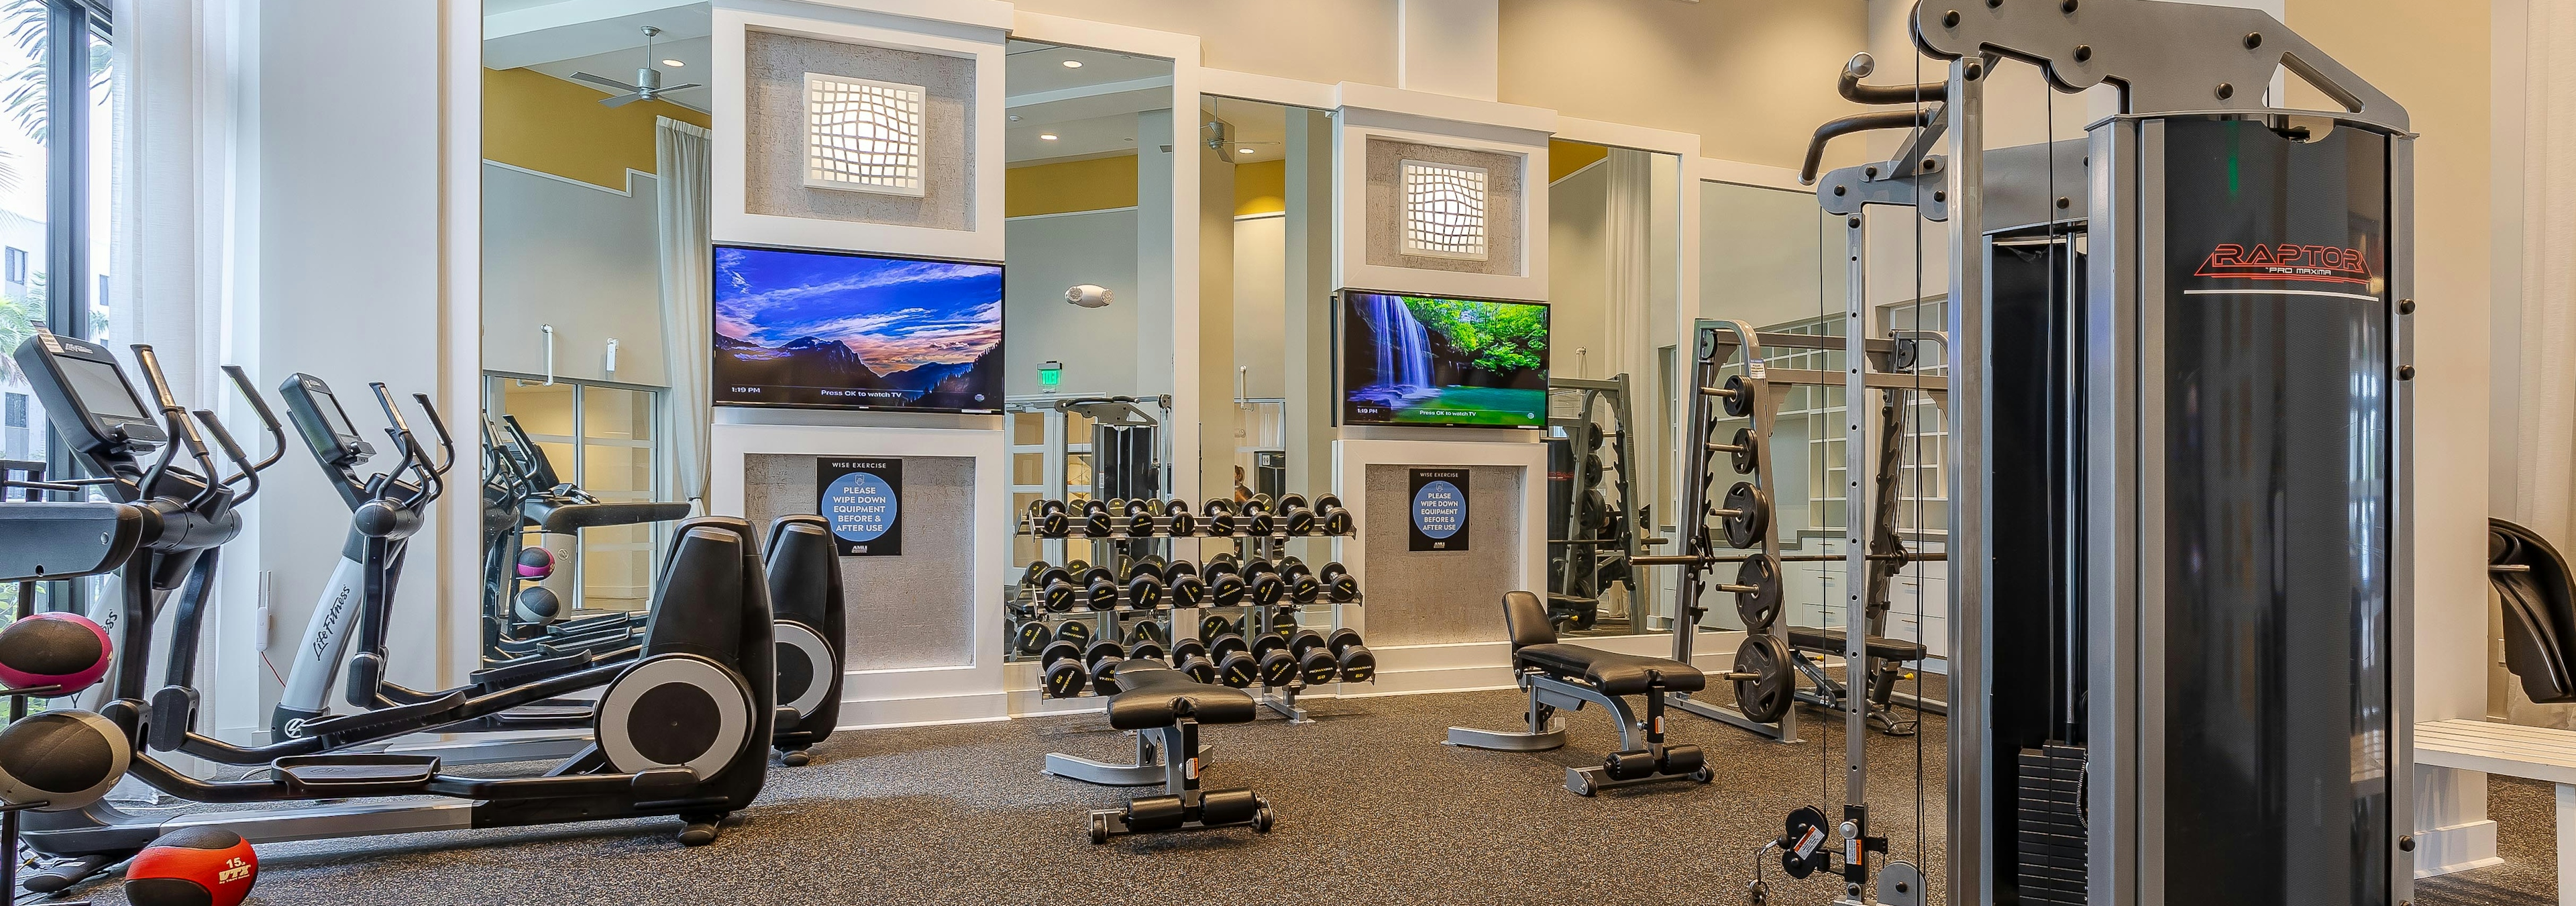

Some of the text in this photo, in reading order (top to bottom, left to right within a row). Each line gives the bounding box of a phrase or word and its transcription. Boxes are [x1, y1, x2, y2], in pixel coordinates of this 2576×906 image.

[2212, 244, 2364, 273] RAPTOR
[1056, 675, 1063, 684] 50
[219, 864, 251, 881] VTX
